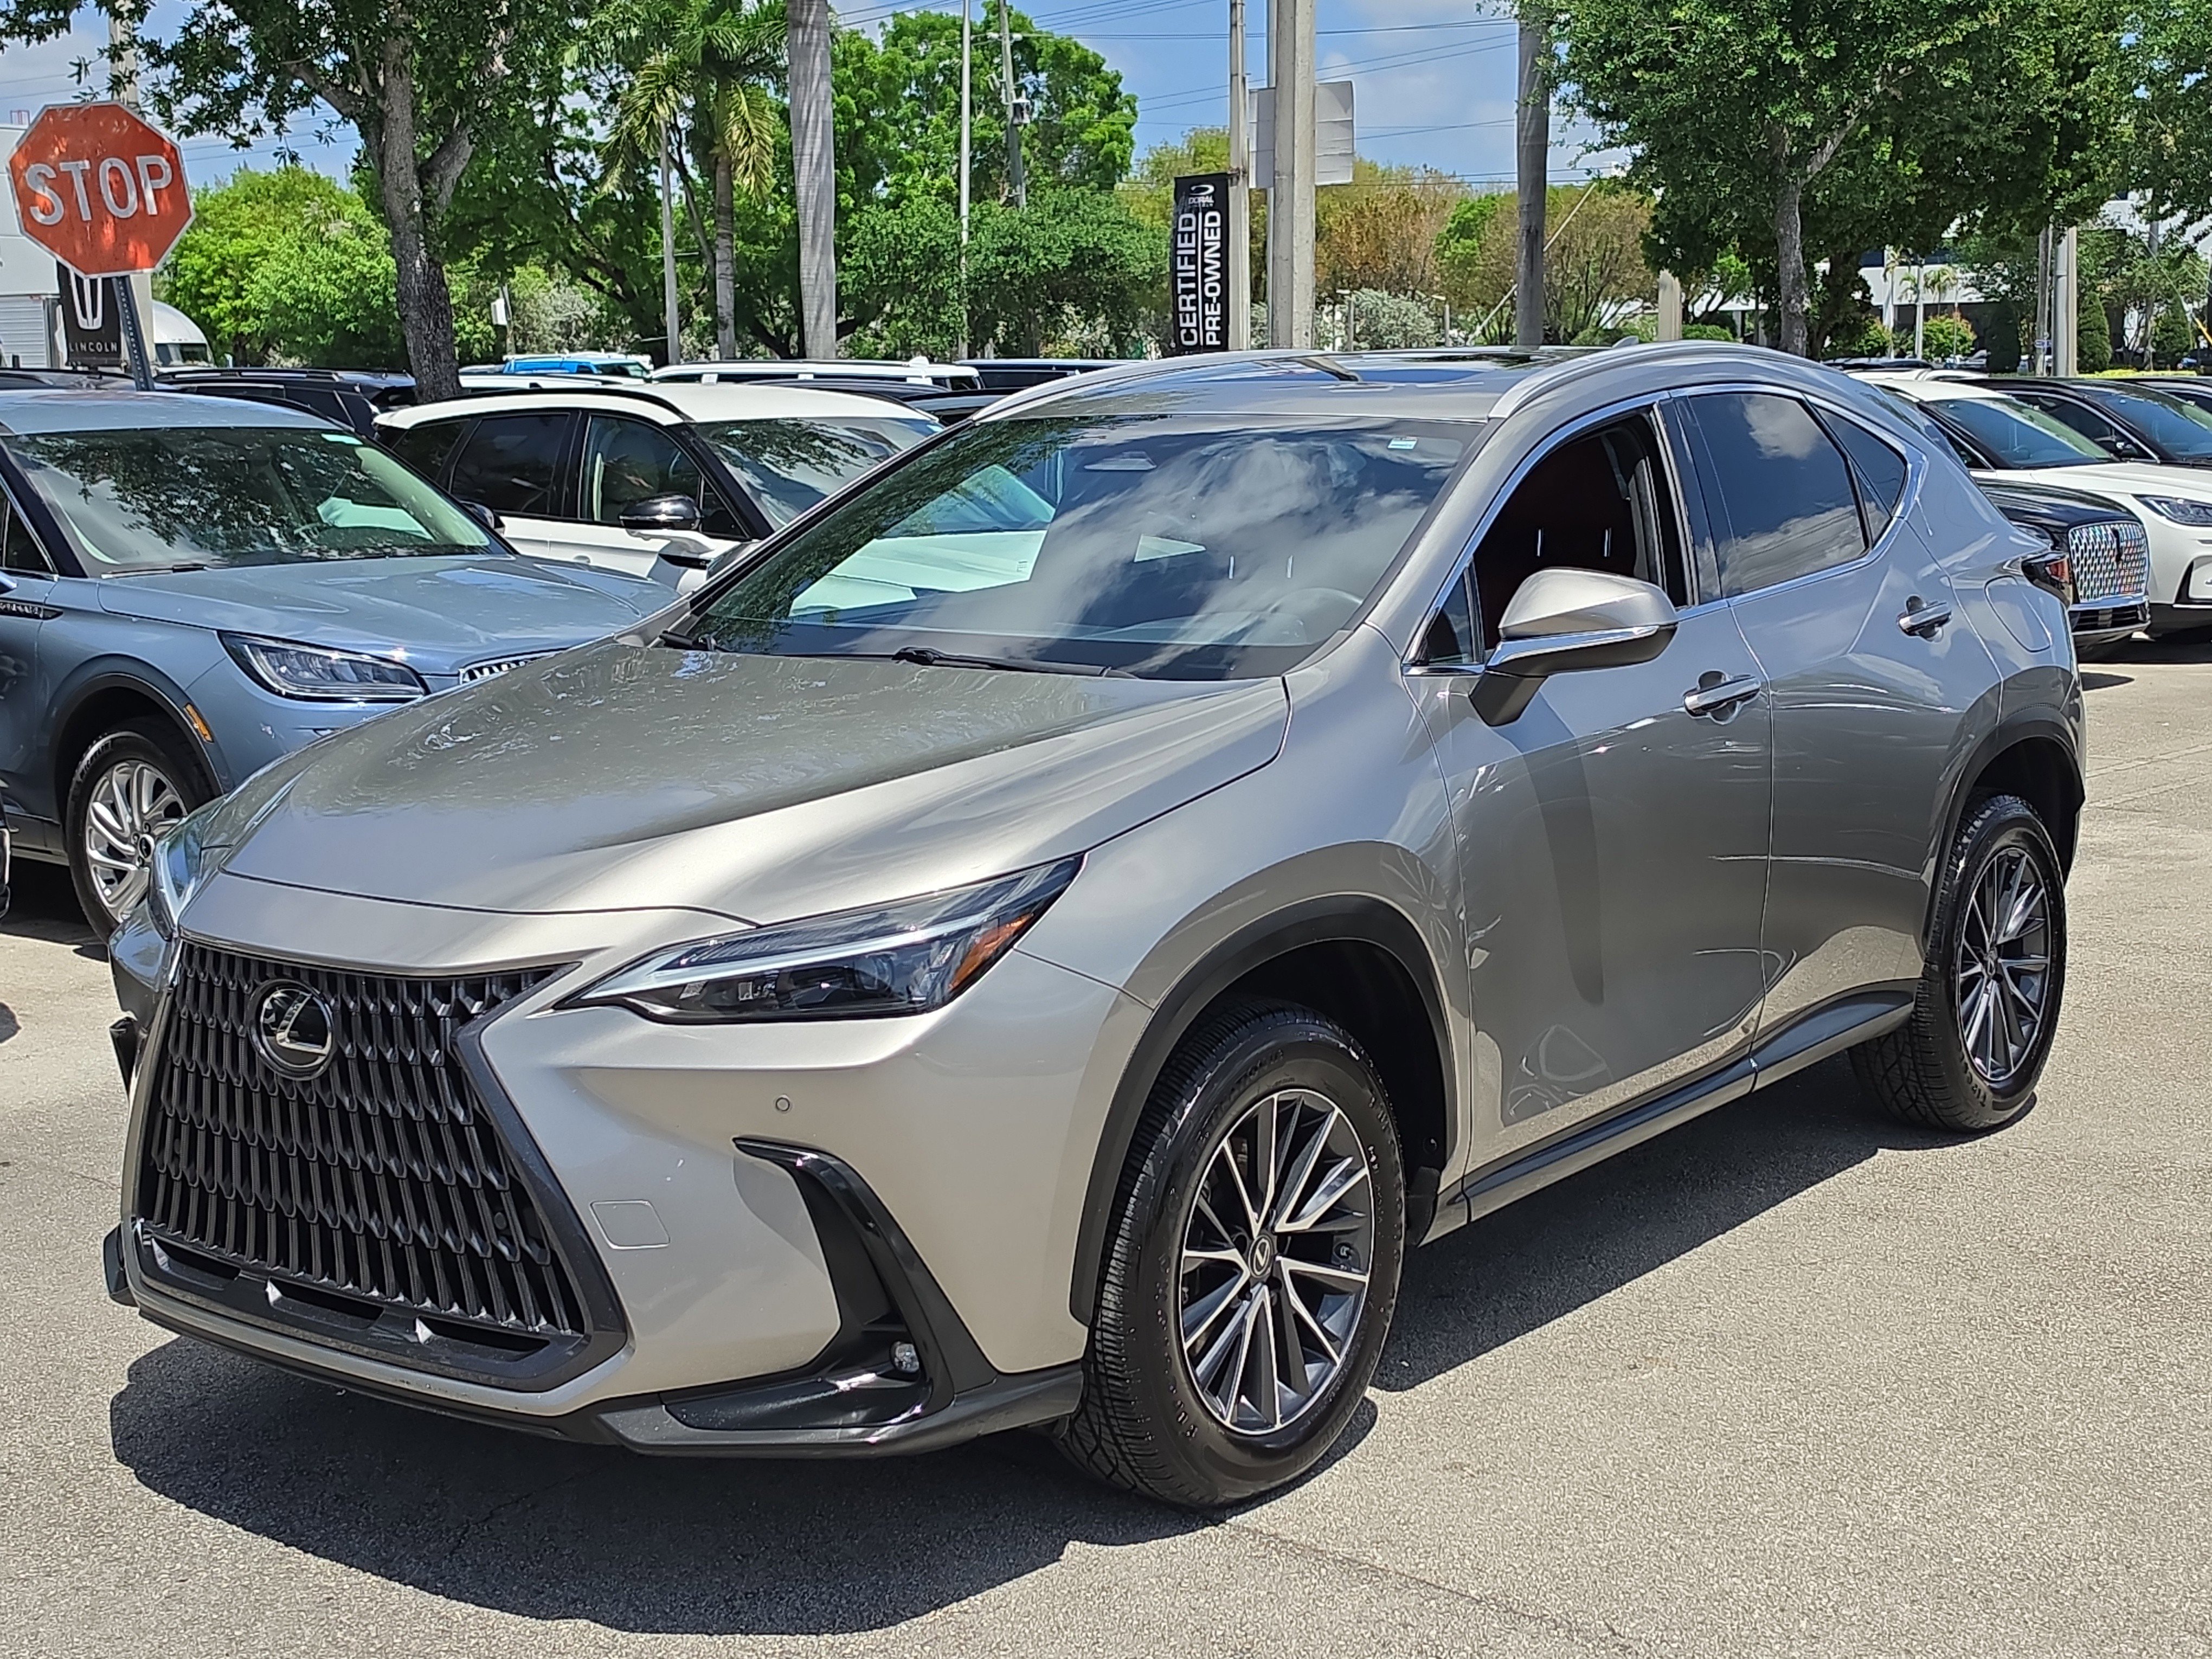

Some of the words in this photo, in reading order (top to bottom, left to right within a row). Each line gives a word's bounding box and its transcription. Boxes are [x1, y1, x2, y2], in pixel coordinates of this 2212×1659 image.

[25, 155, 172, 226] STOP
[1176, 213, 1198, 346] CERTIFIED
[1204, 211, 1220, 346] PRE-OWNED
[69, 342, 117, 352] LINCOLN
